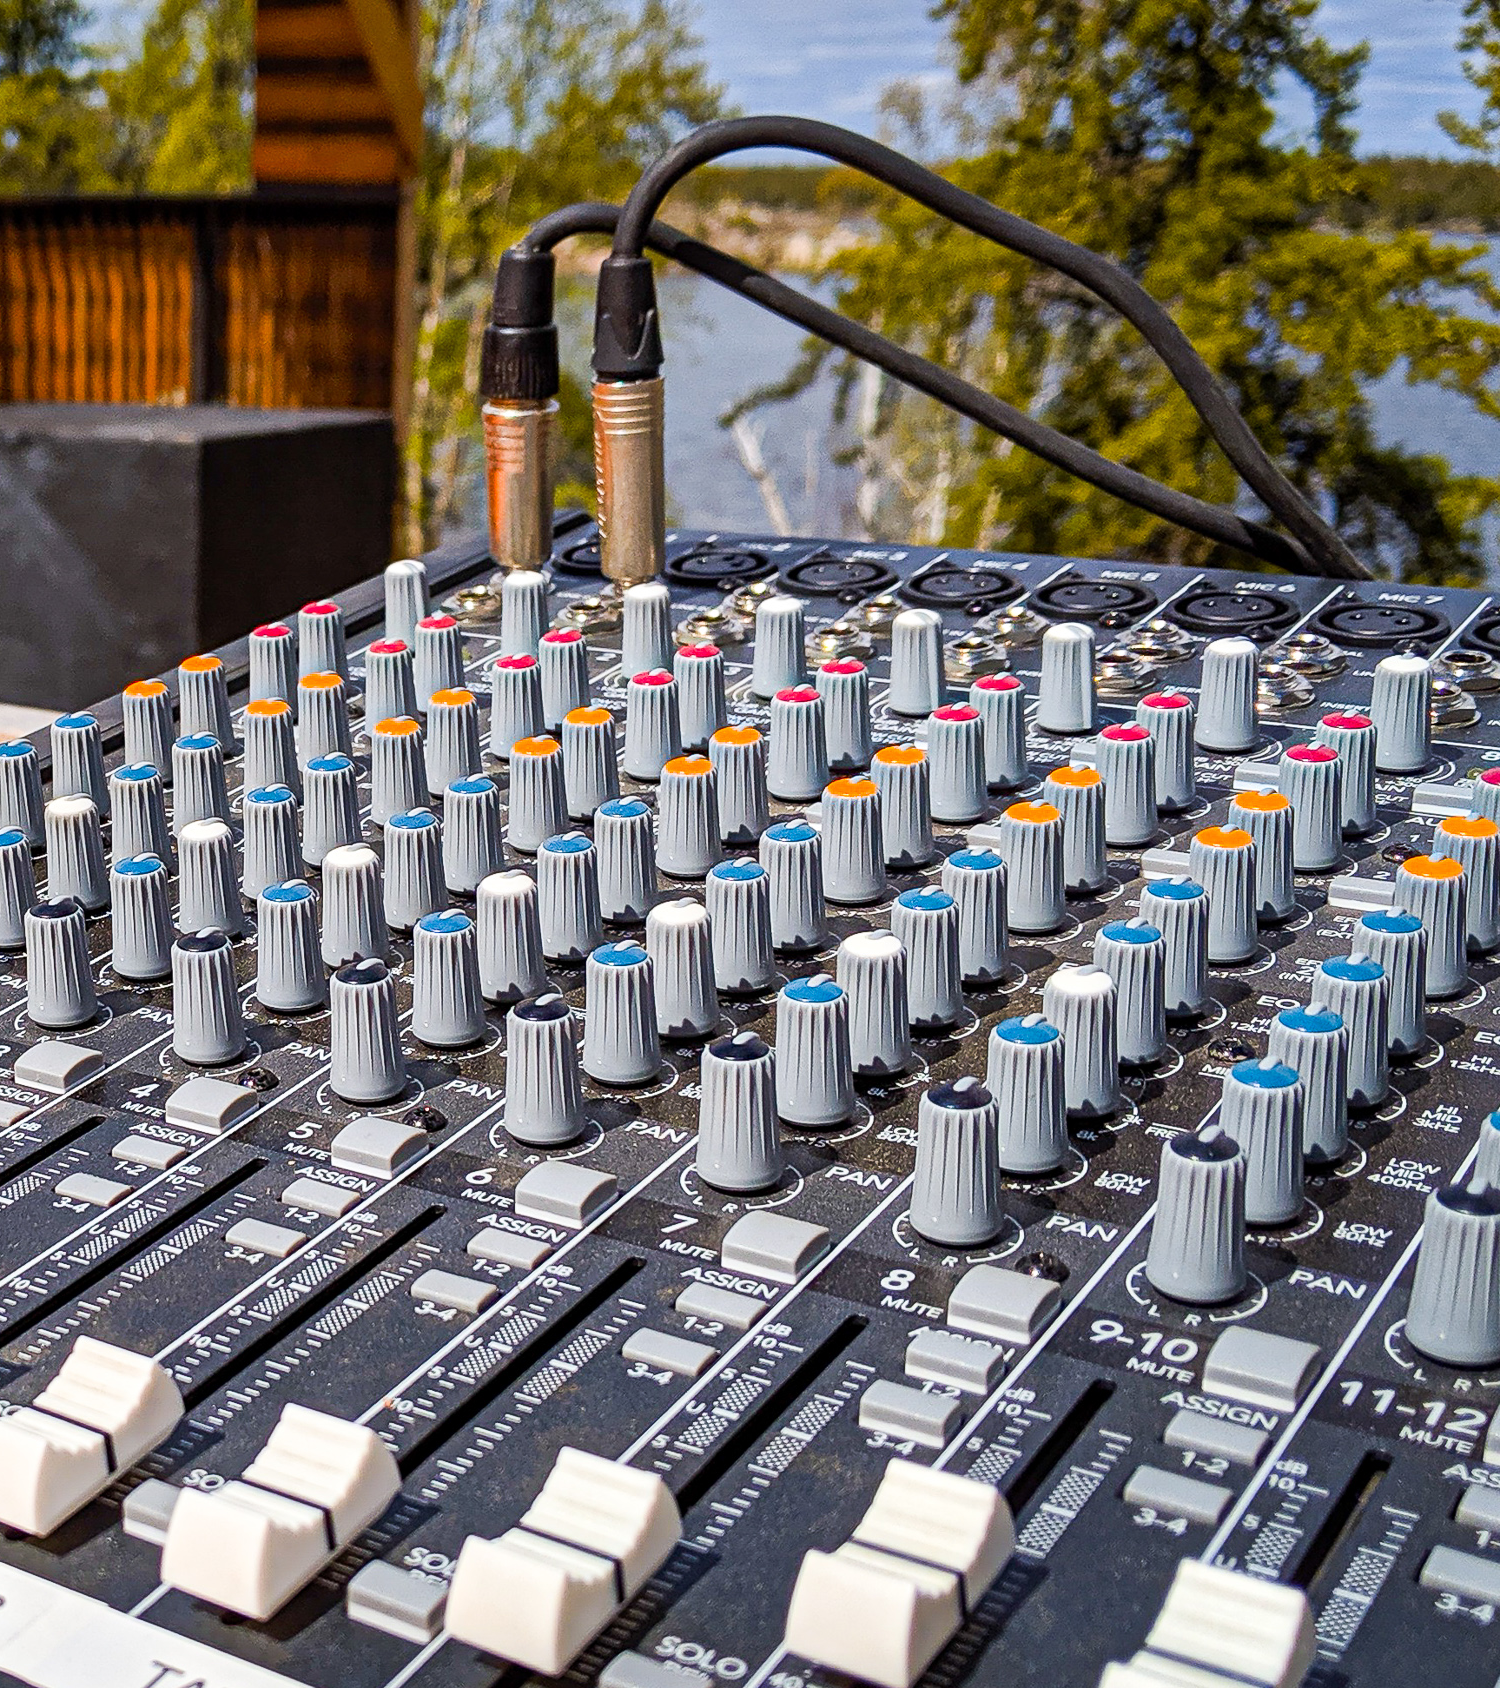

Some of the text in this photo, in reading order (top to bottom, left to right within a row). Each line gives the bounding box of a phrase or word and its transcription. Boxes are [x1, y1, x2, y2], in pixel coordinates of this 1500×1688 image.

[1234, 580, 1296, 593] MIC 6
[1378, 592, 1445, 605] MIC 7
[1372, 871, 1391, 881] 2
[281, 1042, 332, 1060] PAN
[1471, 1055, 1493, 1065] HI
[129, 1083, 160, 1099] 4
[444, 1079, 503, 1100] PAN
[121, 1101, 166, 1118] MUTE
[1422, 1109, 1463, 1124] MID
[1436, 1104, 1460, 1115] HI
[19, 1122, 42, 1132] dB
[288, 1121, 323, 1139] 5
[625, 1121, 688, 1144] PAN
[1145, 1127, 1180, 1141] FRE
[1412, 1117, 1461, 1134] 3kHz
[6, 1131, 27, 1141] 10
[129, 1122, 205, 1147] ASSIGN
[282, 1142, 331, 1162] MUTE
[113, 1161, 148, 1177] 1-2
[178, 1164, 202, 1175] dB
[1383, 1166, 1426, 1181] MID
[1389, 1158, 1442, 1175] LOW
[165, 1175, 185, 1185] 10
[295, 1165, 377, 1193] ASSIGN
[465, 1167, 497, 1185] 6
[825, 1166, 893, 1191] PAN
[1100, 1170, 1151, 1188] LOW
[1367, 1174, 1433, 1194] 400Hz
[52, 1197, 90, 1213] 3-4
[127, 1199, 144, 1210] 5
[460, 1187, 514, 1208] MUTE
[283, 1207, 320, 1225] 1-2
[722, 1202, 739, 1214] R
[353, 1211, 379, 1223] dB
[661, 1213, 699, 1234] 7
[341, 1222, 362, 1234] 10
[477, 1213, 568, 1244] ASSIGN
[1046, 1215, 1119, 1242] PAN
[1338, 1220, 1393, 1239] LOW
[50, 1250, 67, 1261] 5
[224, 1246, 264, 1265] 3-4
[304, 1249, 320, 1261] 5
[658, 1238, 718, 1262] MUTE
[471, 1258, 511, 1277] 1-2
[546, 1264, 575, 1277] dB
[941, 1256, 959, 1268] R
[10, 1277, 31, 1290] 10
[266, 1276, 285, 1288] U
[535, 1275, 558, 1288] 10
[680, 1266, 780, 1300] ASSIGN
[880, 1269, 916, 1291] 8
[1288, 1270, 1367, 1299] PAN
[228, 1304, 246, 1317] 5
[414, 1301, 458, 1322] 3-4
[500, 1305, 518, 1317] 5
[880, 1295, 944, 1319] MUTE
[683, 1316, 725, 1337] 1-2
[1183, 1313, 1202, 1327] R
[762, 1322, 793, 1337] dB
[189, 1334, 212, 1348] 10
[463, 1335, 484, 1348] U
[752, 1334, 778, 1349] 10
[1089, 1319, 1199, 1364] 9-10
[427, 1365, 446, 1379] 5
[626, 1362, 675, 1386] 3-4
[719, 1367, 738, 1381] 5
[1125, 1357, 1196, 1384] MUTE
[1413, 1369, 1427, 1382] L
[920, 1381, 962, 1399] 1-2
[1453, 1378, 1472, 1393] R
[1004, 1388, 1036, 1403] dB
[684, 1400, 707, 1414] U
[996, 1400, 1023, 1417] 10
[1160, 1391, 1280, 1432] ASSIGN
[1340, 1381, 1488, 1437] 11-12
[651, 1434, 671, 1449] 5
[865, 1431, 915, 1456] 3-4
[965, 1437, 984, 1451] 5
[1399, 1425, 1475, 1454] MUTE
[1181, 1450, 1230, 1477] 1-2
[1275, 1459, 1309, 1477] dB
[1268, 1473, 1296, 1492] 10
[1133, 1507, 1189, 1536] 3-4
[1241, 1513, 1262, 1531] 5
[1434, 1593, 1495, 1625] 3-4
[655, 1635, 748, 1680] SOLO
